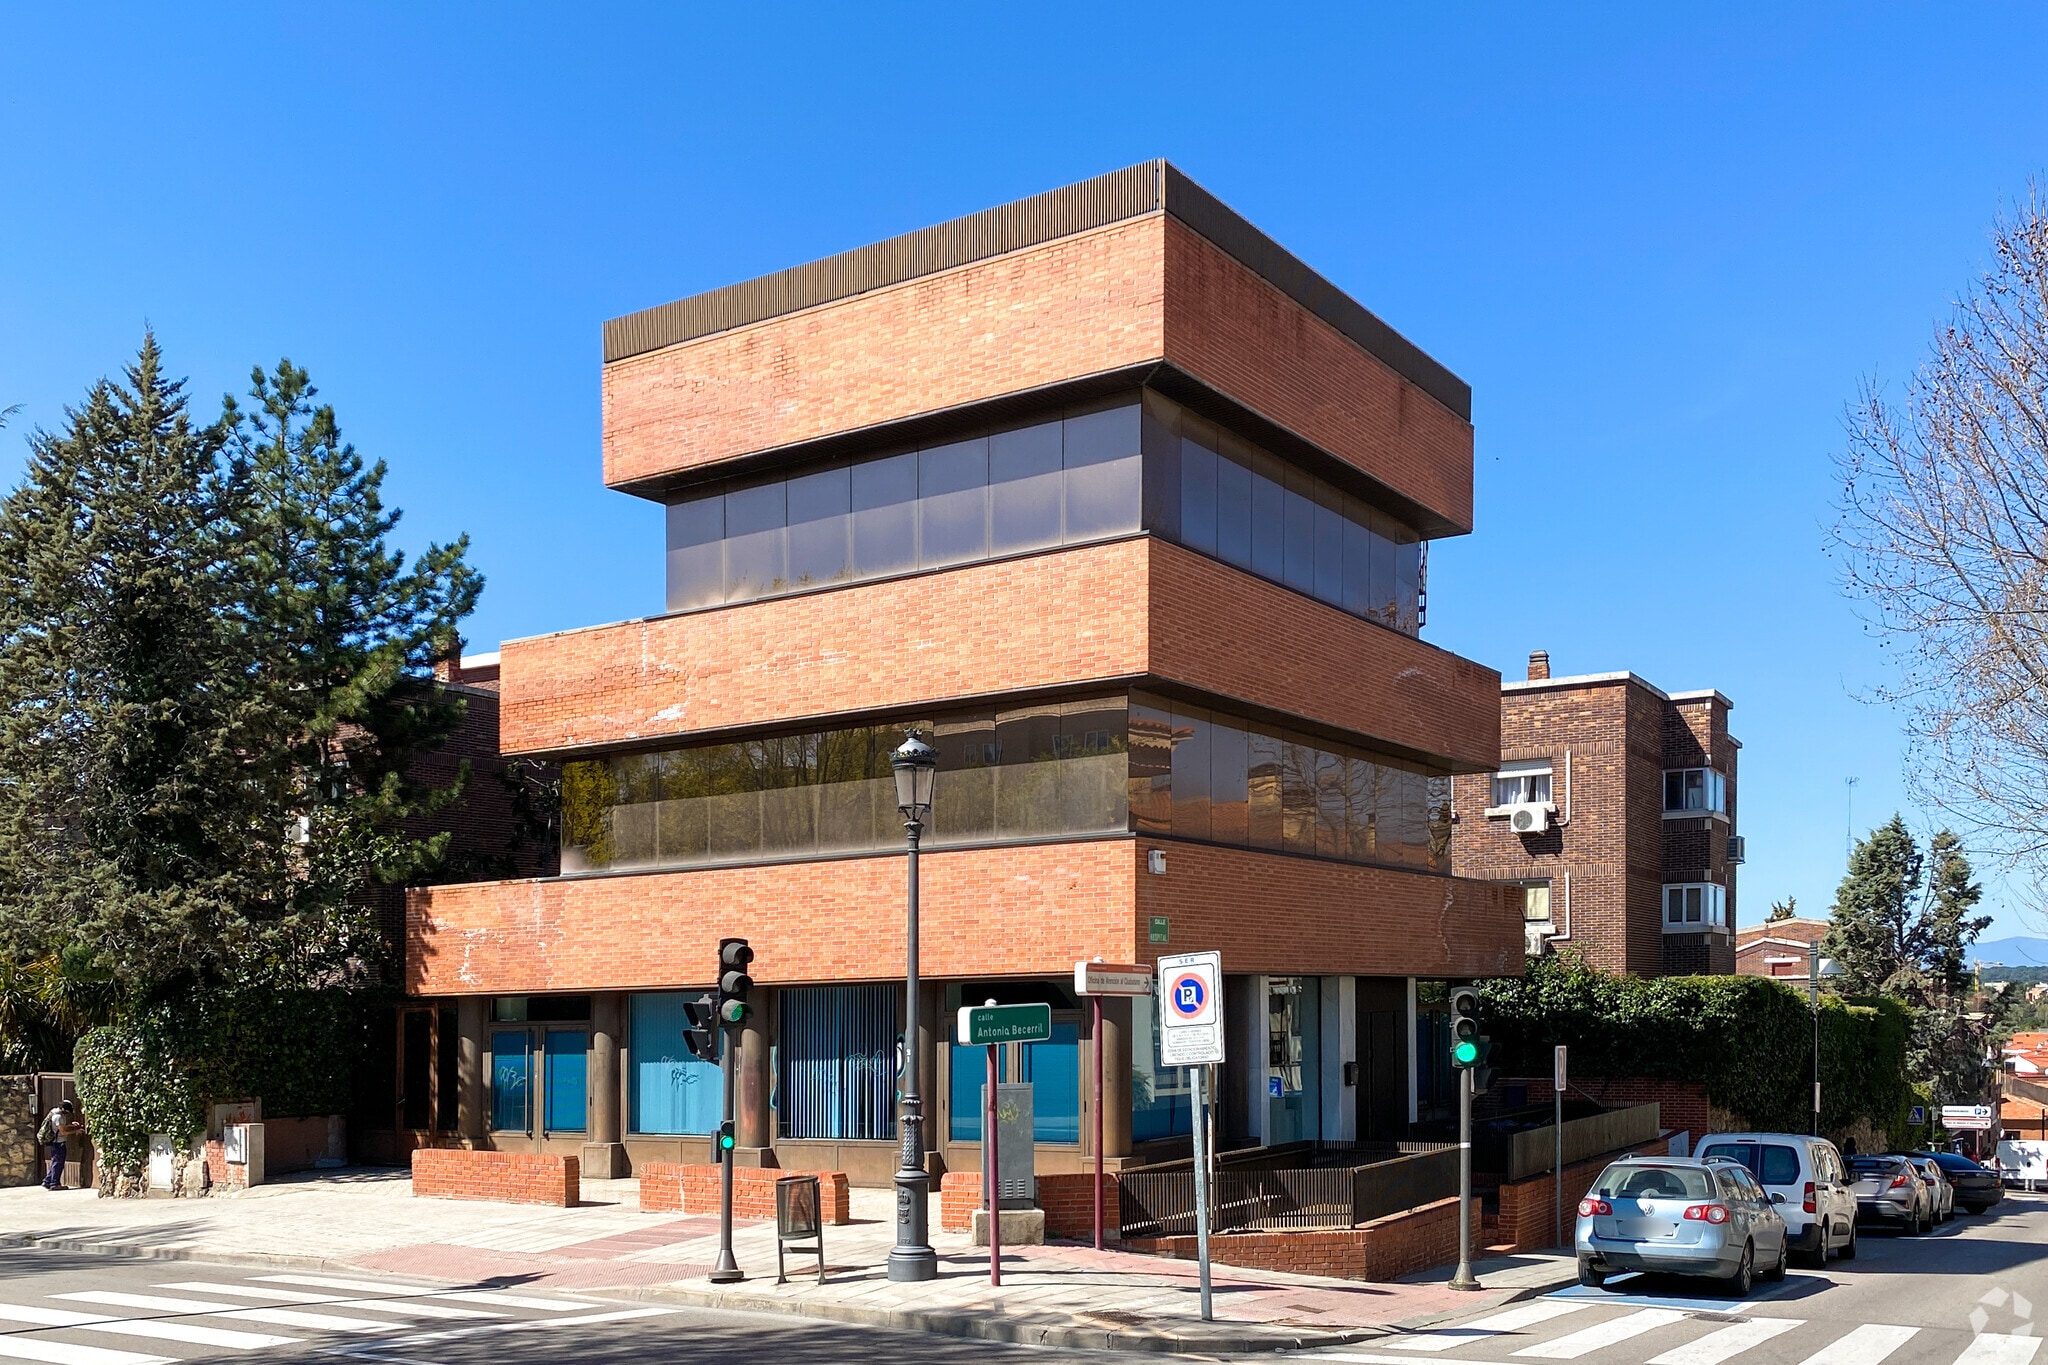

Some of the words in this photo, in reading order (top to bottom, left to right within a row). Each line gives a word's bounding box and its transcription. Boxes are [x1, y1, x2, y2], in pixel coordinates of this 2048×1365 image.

[1087, 976, 1100, 985] Oficina
[977, 1013, 994, 1022] calle
[977, 1026, 1010, 1038] Antonia
[1012, 1023, 1043, 1035] Becerril
